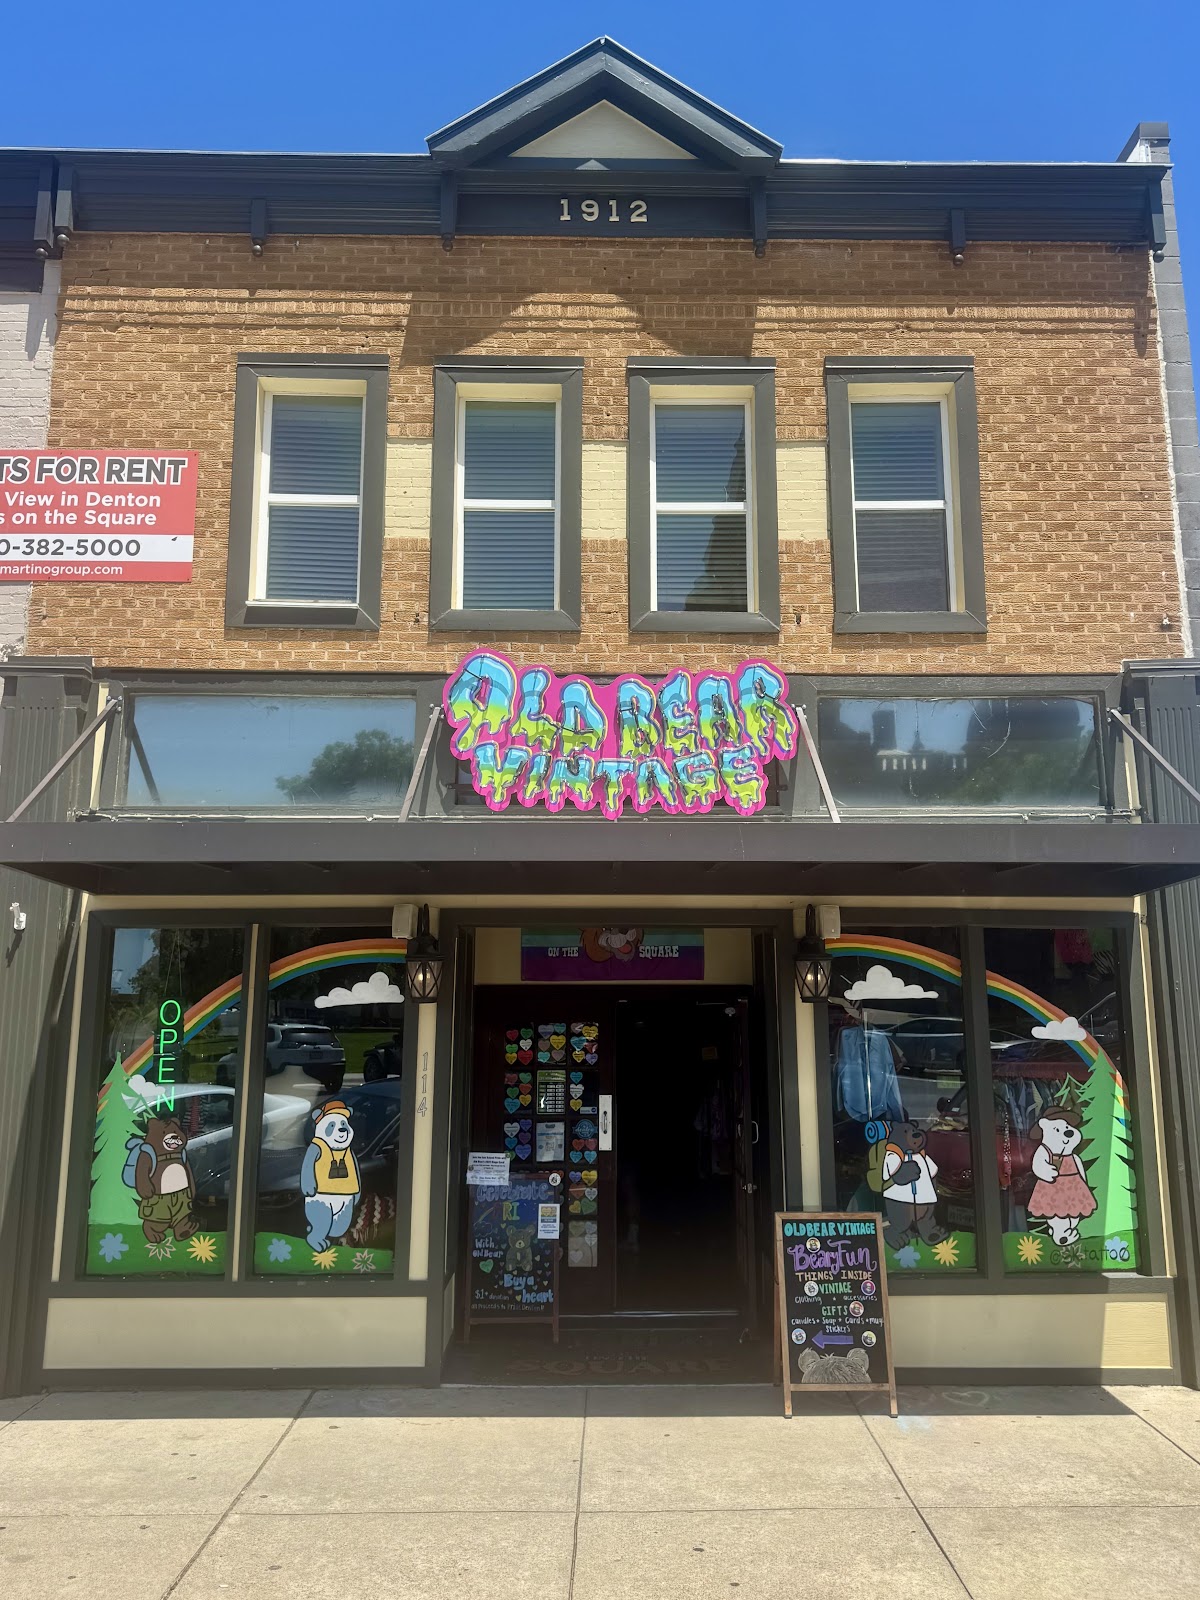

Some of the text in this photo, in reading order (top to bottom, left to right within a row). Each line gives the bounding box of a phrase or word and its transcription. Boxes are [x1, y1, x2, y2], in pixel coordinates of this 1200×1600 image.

[560, 198, 648, 223] 1912
[35, 457, 99, 485] FOR
[105, 457, 188, 486] RENT
[5, 491, 161, 508] View in Denton
[12, 513, 37, 525] on
[45, 511, 78, 526] the
[84, 511, 157, 528] Square
[0, 538, 141, 557] 0-382-5000
[0, 564, 123, 577] martinogroup.com
[616, 662, 797, 759] BEAR
[474, 741, 768, 814] VINTAGE
[547, 946, 579, 957] ON THE
[639, 945, 679, 959] SQUARE
[156, 999, 182, 1112] OPEN
[417, 1051, 428, 1118] 114
[837, 1222, 875, 1235] VINTAGE
[503, 1273, 526, 1291] Buy
[795, 1270, 873, 1282] THINGS INSIDE
[521, 1288, 554, 1303] heart
[818, 1282, 853, 1294] VINTAGE
[821, 1305, 848, 1316] GIFTS
